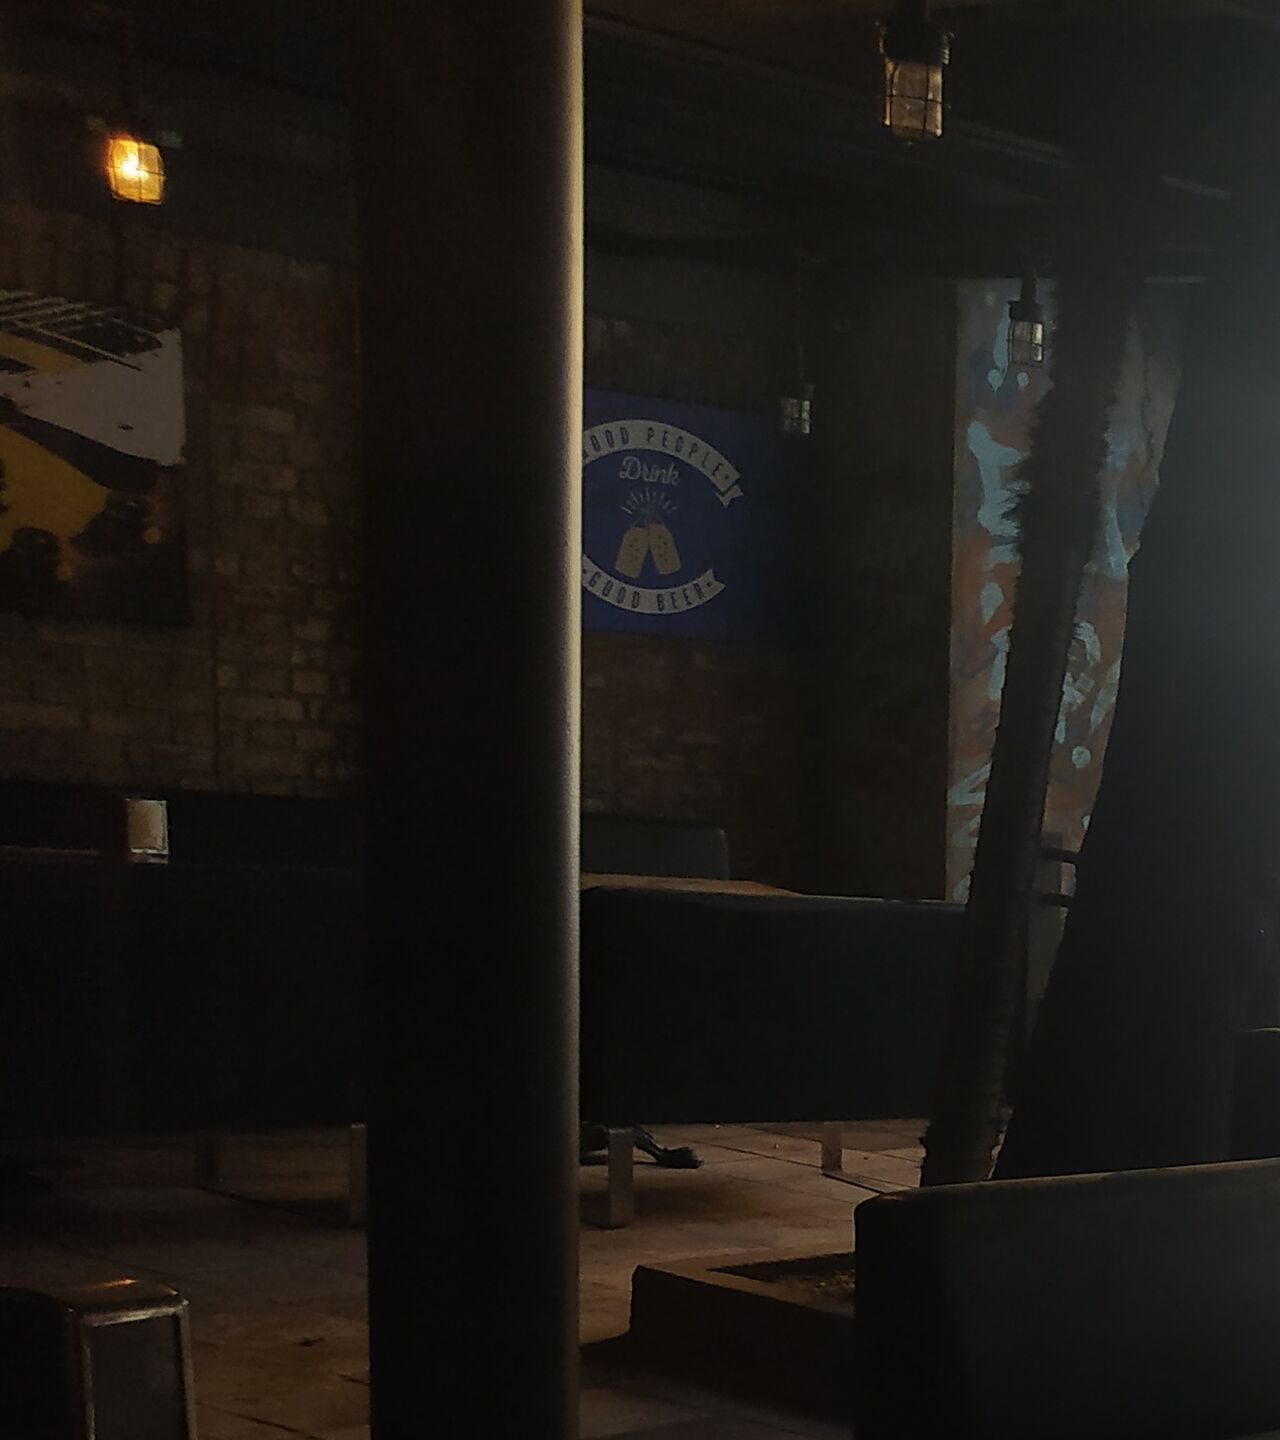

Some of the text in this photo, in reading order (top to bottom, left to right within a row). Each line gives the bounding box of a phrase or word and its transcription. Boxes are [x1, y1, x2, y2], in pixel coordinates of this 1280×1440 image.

[618, 456, 681, 486] Drink
[647, 427, 722, 477] PEOPLE
[588, 572, 705, 611] GOOD BEER
